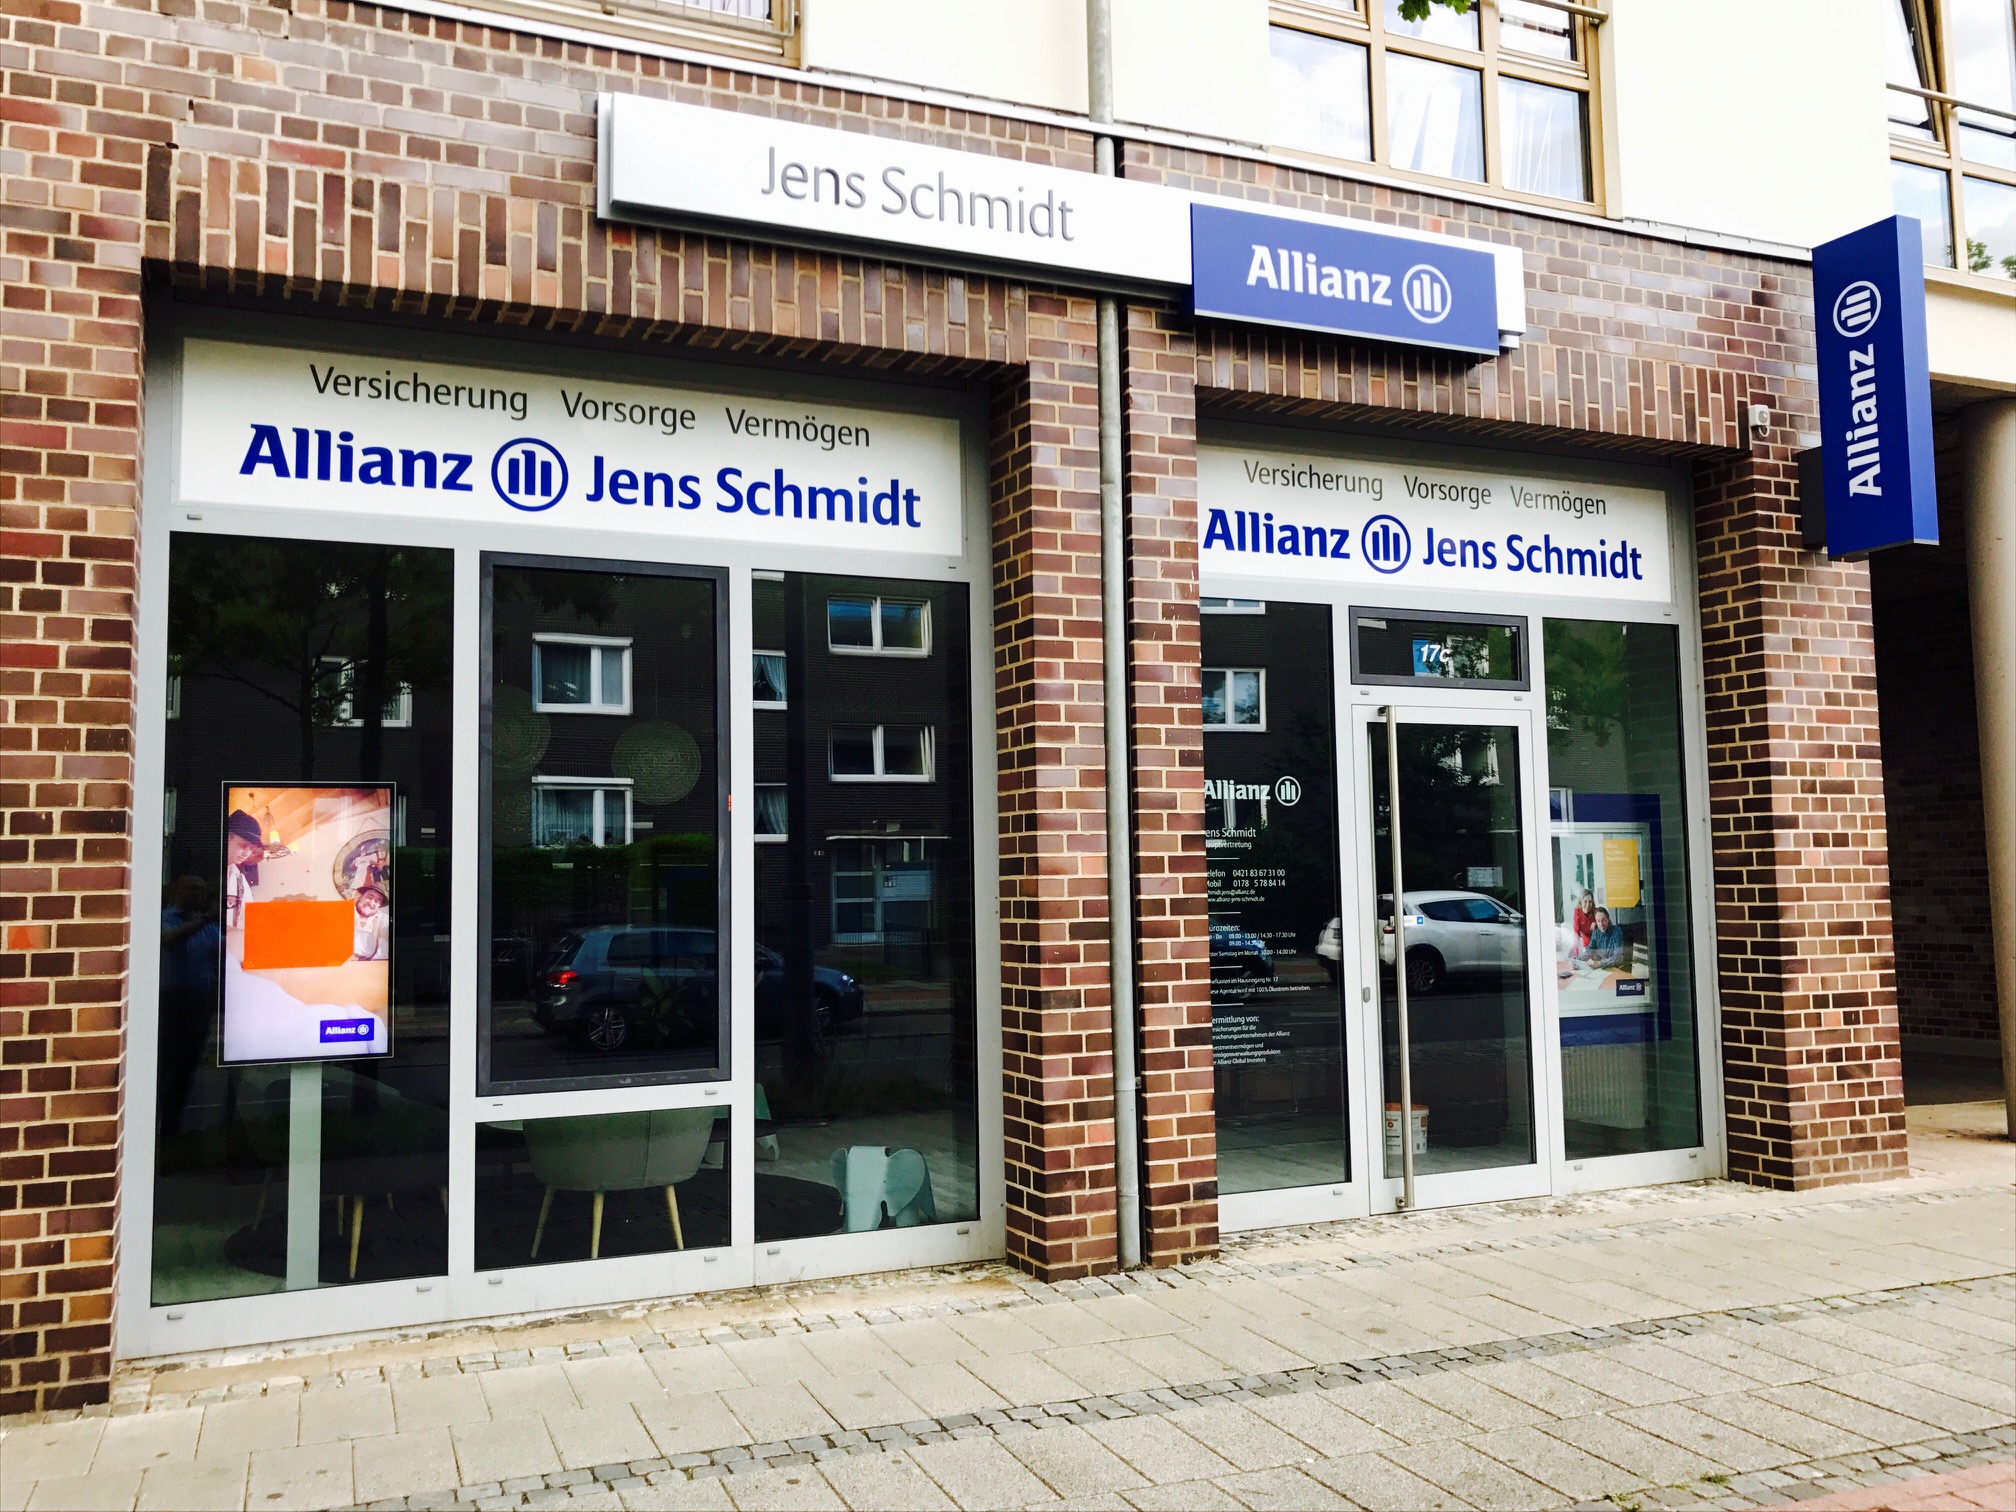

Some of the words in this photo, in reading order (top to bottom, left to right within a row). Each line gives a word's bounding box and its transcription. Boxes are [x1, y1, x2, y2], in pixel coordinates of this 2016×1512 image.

[761, 146, 866, 209] Jens
[881, 166, 1075, 241] Schmidt
[1246, 244, 1393, 306] Allianz
[309, 364, 528, 421] Versicherung
[561, 389, 696, 435] Vorsorge
[725, 407, 871, 451] Vermögen
[1845, 343, 1882, 497] Allianz
[239, 423, 473, 492] Allianz
[586, 455, 701, 510] Jens
[716, 466, 921, 528] Schmidt
[1243, 459, 1383, 501] Versicherung
[1404, 475, 1492, 509] Vorsorge
[1510, 485, 1607, 519] Vermögen
[1203, 508, 1350, 559] Allianz
[1423, 527, 1497, 570] Jens
[1506, 534, 1643, 580] Schmidt
[1420, 644, 1453, 663] 17c
[1204, 779, 1271, 800] Allianz
[1205, 828, 1220, 838] ens
[1222, 827, 1257, 838] Schmidt
[1207, 869, 1226, 878] elefon
[1232, 869, 1248, 877] 0421
[1249, 869, 1258, 877] 83
[1258, 869, 1267, 877] 67
[325, 1026, 356, 1035] Allianz
[1212, 1015, 1245, 1024] ermittlung
